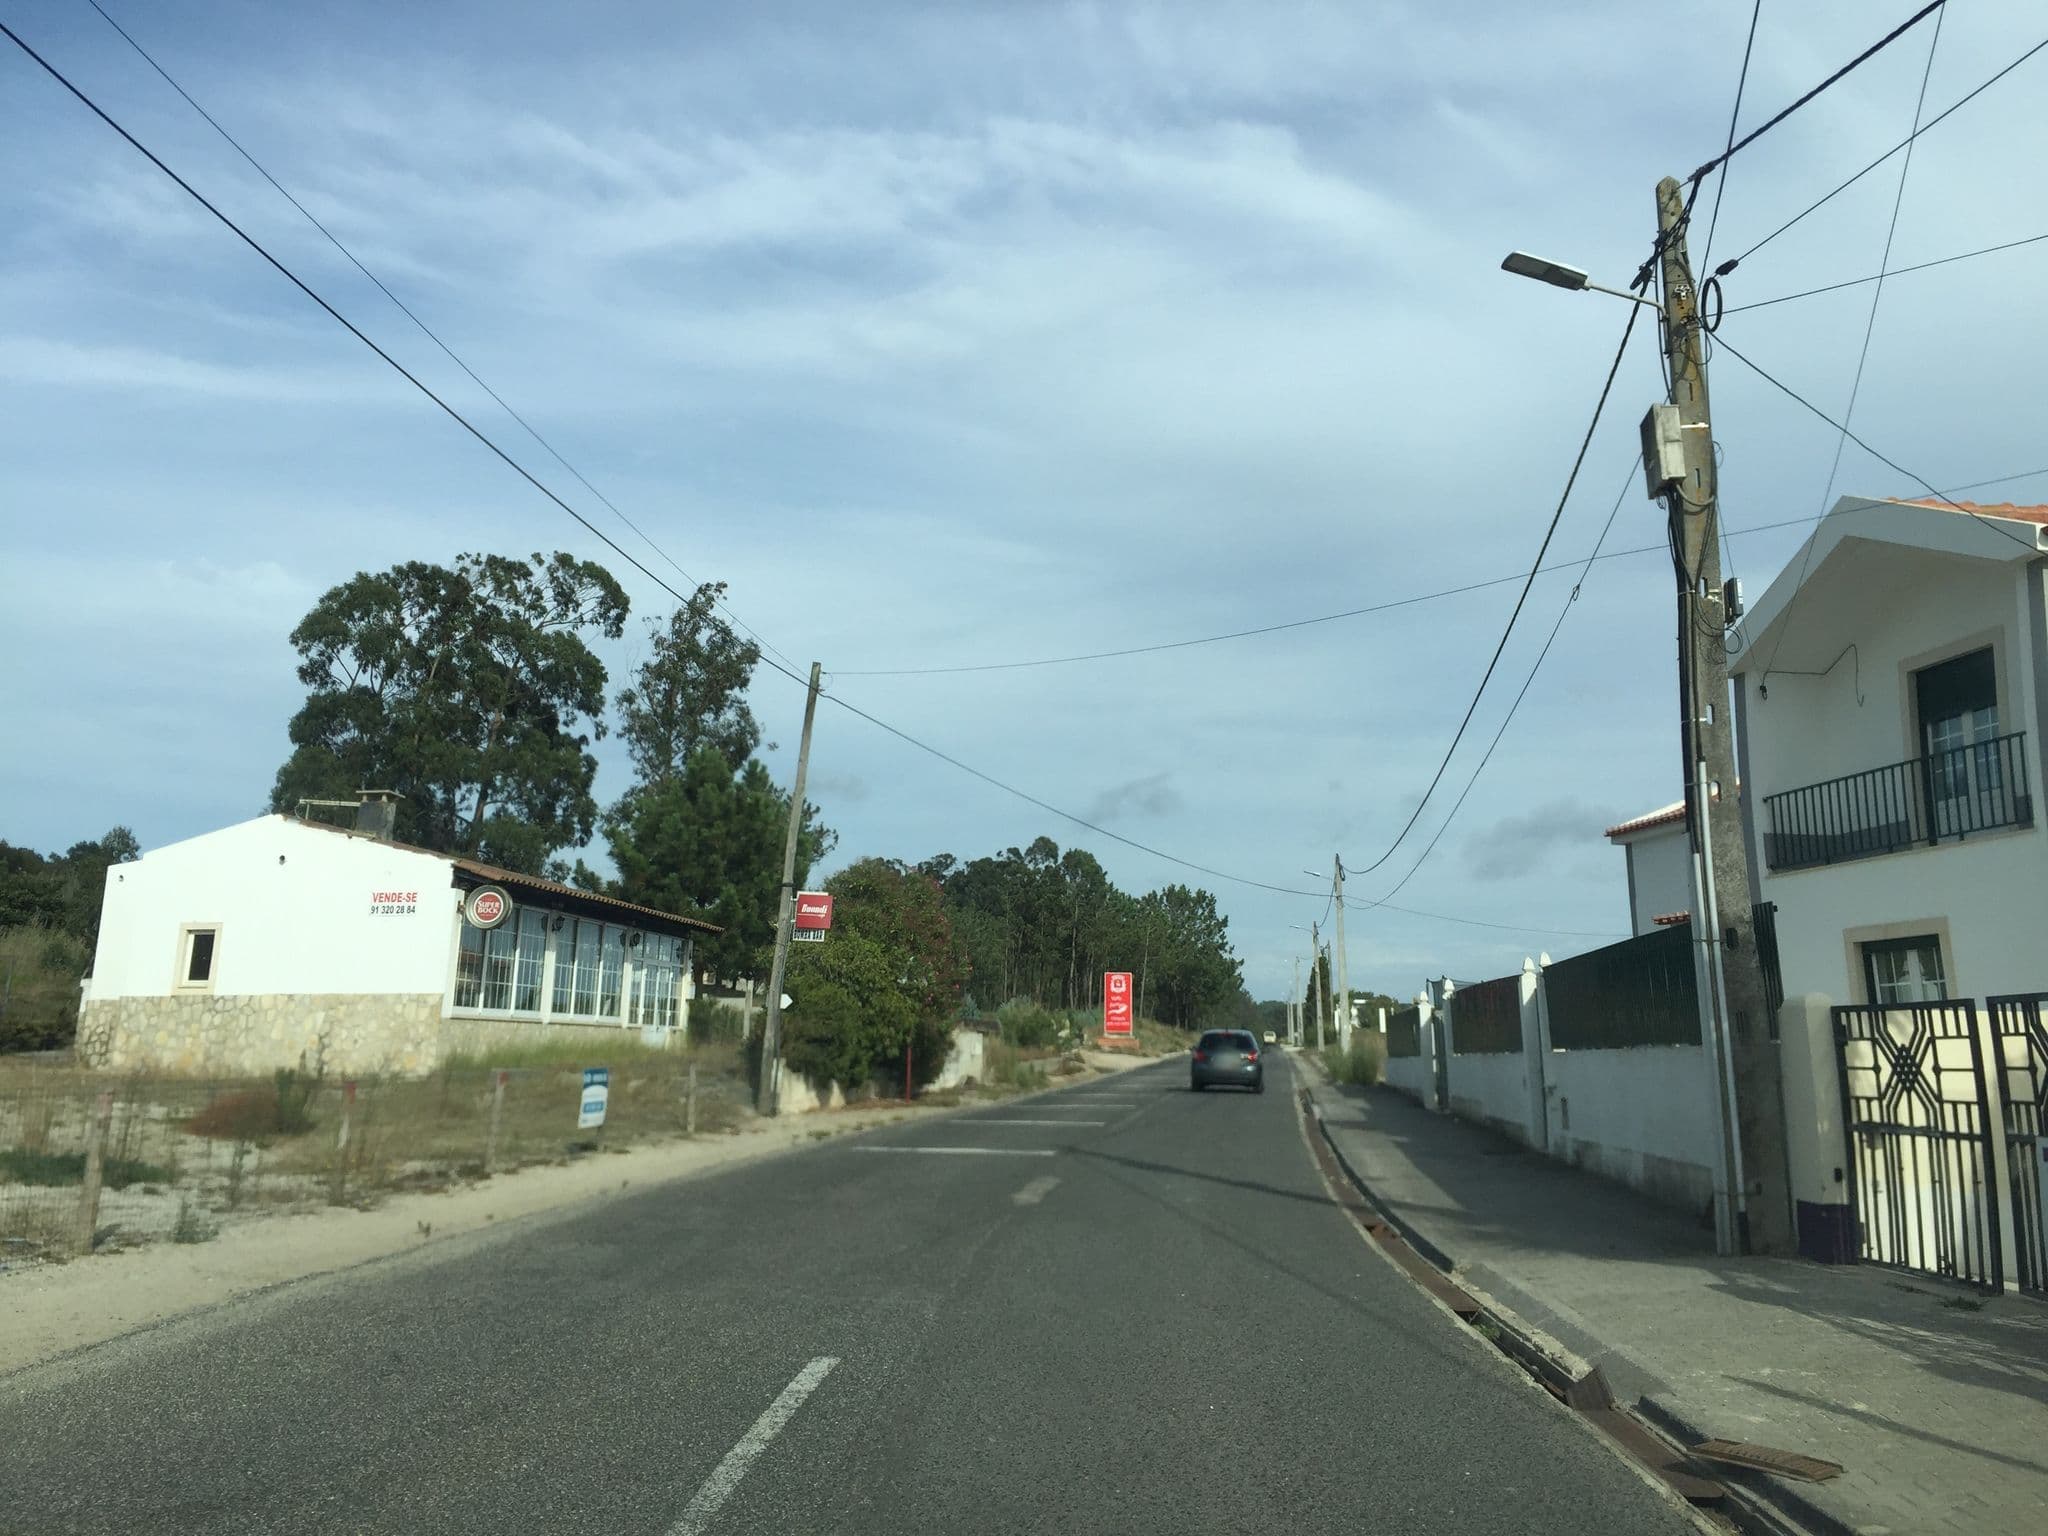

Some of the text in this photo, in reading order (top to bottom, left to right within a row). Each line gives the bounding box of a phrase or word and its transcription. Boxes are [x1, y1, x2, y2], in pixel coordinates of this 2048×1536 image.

[372, 892, 418, 903] VENDE-SE
[477, 900, 500, 908] SUPER
[371, 905, 416, 914] 91 320 28 84
